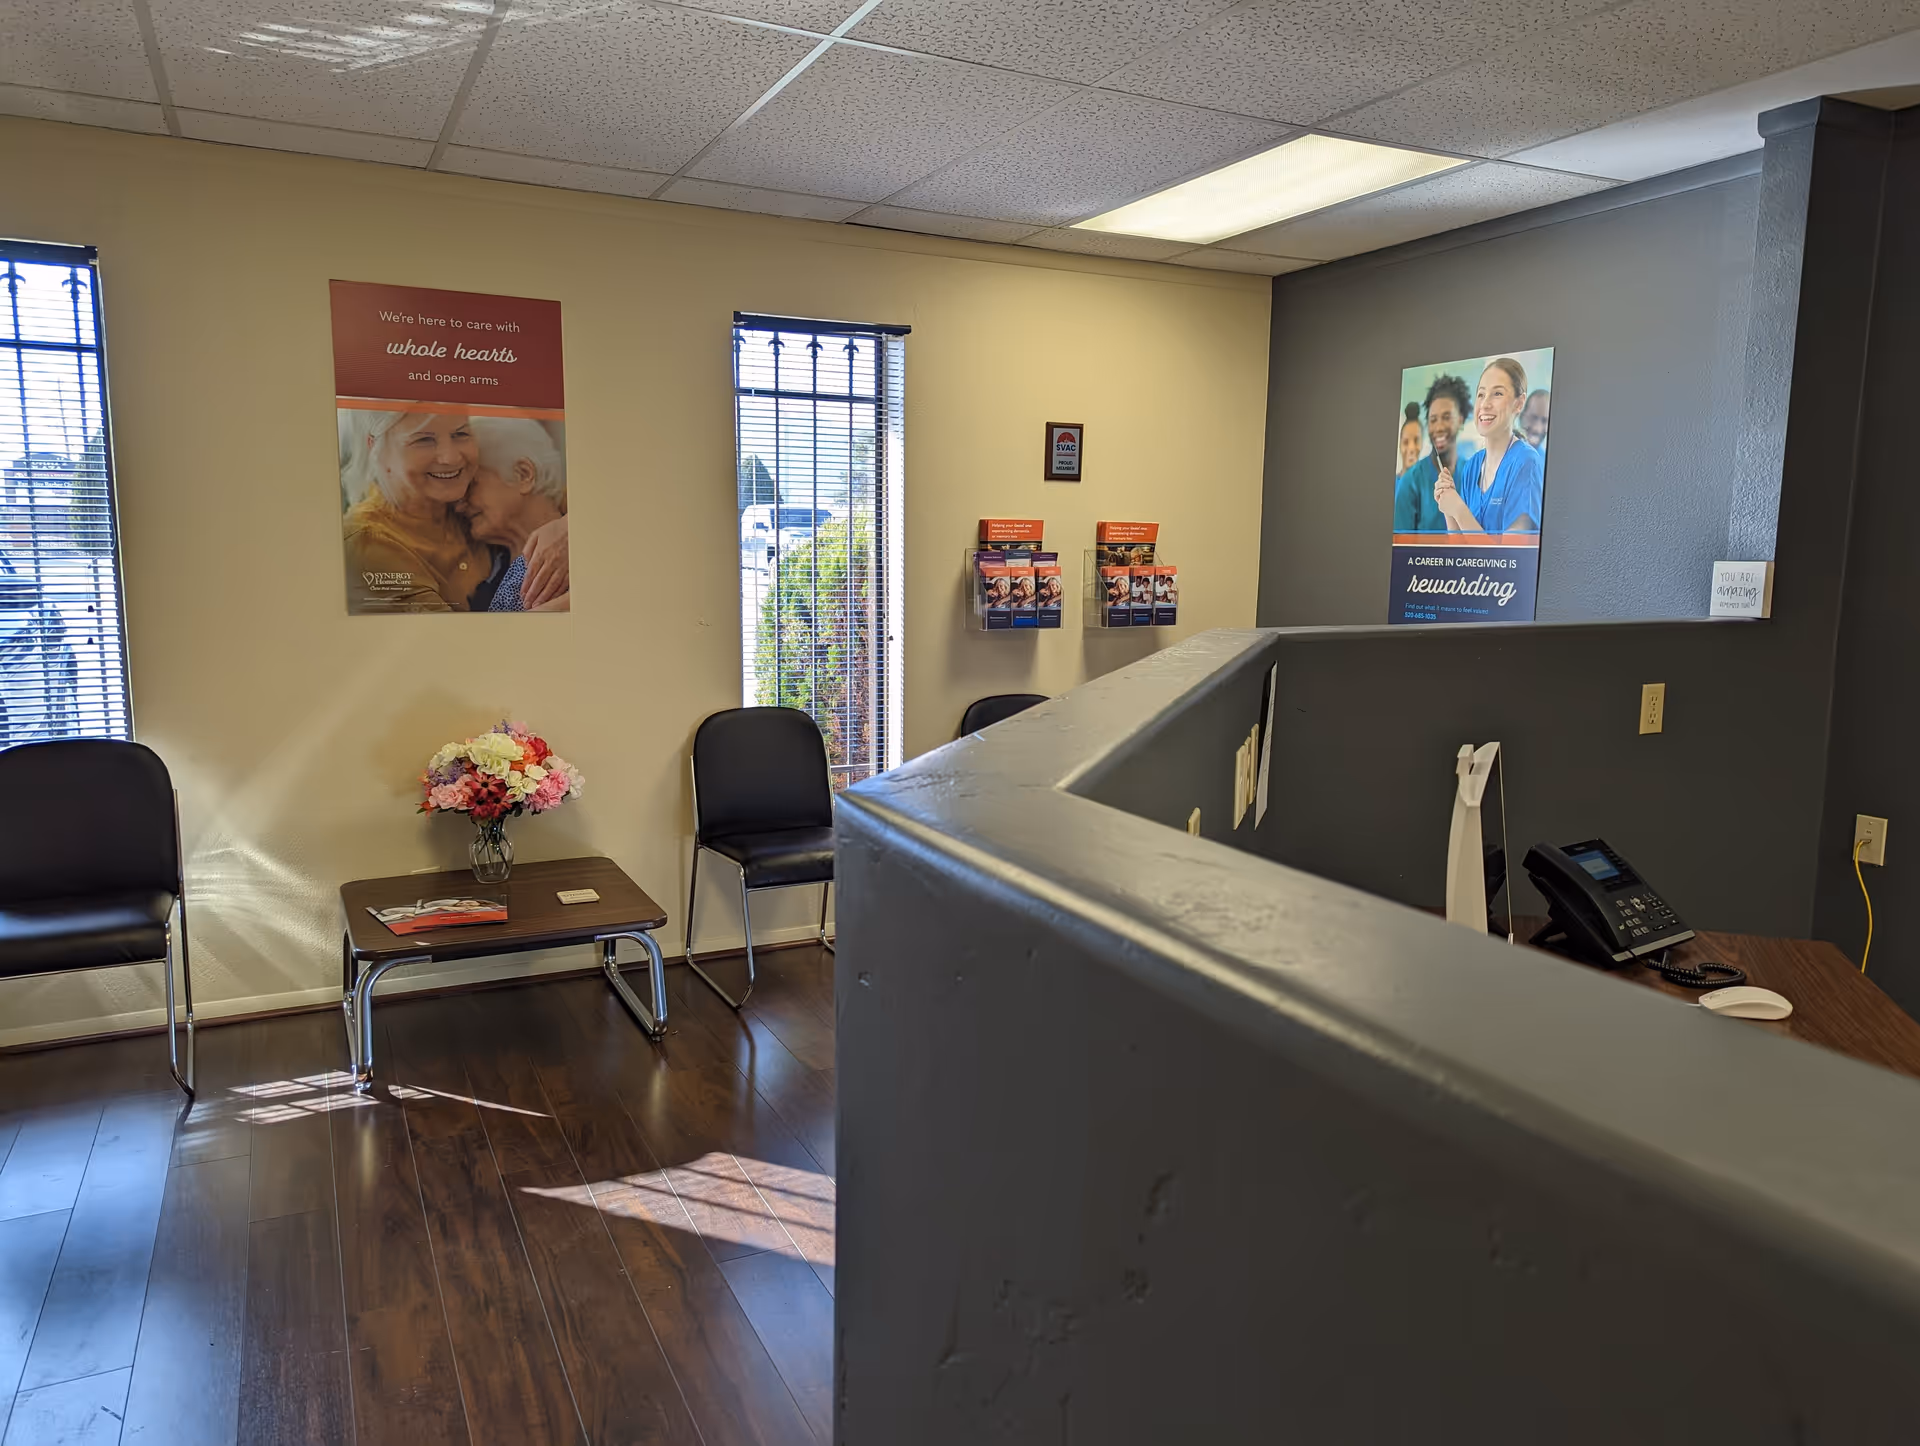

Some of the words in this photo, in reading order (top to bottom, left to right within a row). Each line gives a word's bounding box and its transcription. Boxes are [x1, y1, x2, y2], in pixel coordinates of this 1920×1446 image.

[378, 310, 414, 324] We're
[418, 313, 447, 326] here
[450, 318, 463, 328] to
[466, 321, 493, 331] care
[496, 321, 520, 333] with
[386, 338, 448, 358] whole
[453, 342, 518, 364] hearts
[408, 370, 431, 381] and
[435, 373, 466, 384] open
[469, 375, 499, 386] arms
[1056, 443, 1076, 452] SVAC
[1407, 557, 1414, 565] A
[1415, 557, 1444, 567] CAREER
[1445, 558, 1454, 567] IN
[1455, 558, 1507, 568] CAREGIVING
[1509, 559, 1517, 569] IS
[1720, 572, 1736, 582] YOU
[1406, 573, 1517, 607] rewarding
[1716, 584, 1760, 606] amazing
[1404, 602, 1415, 610] Find
